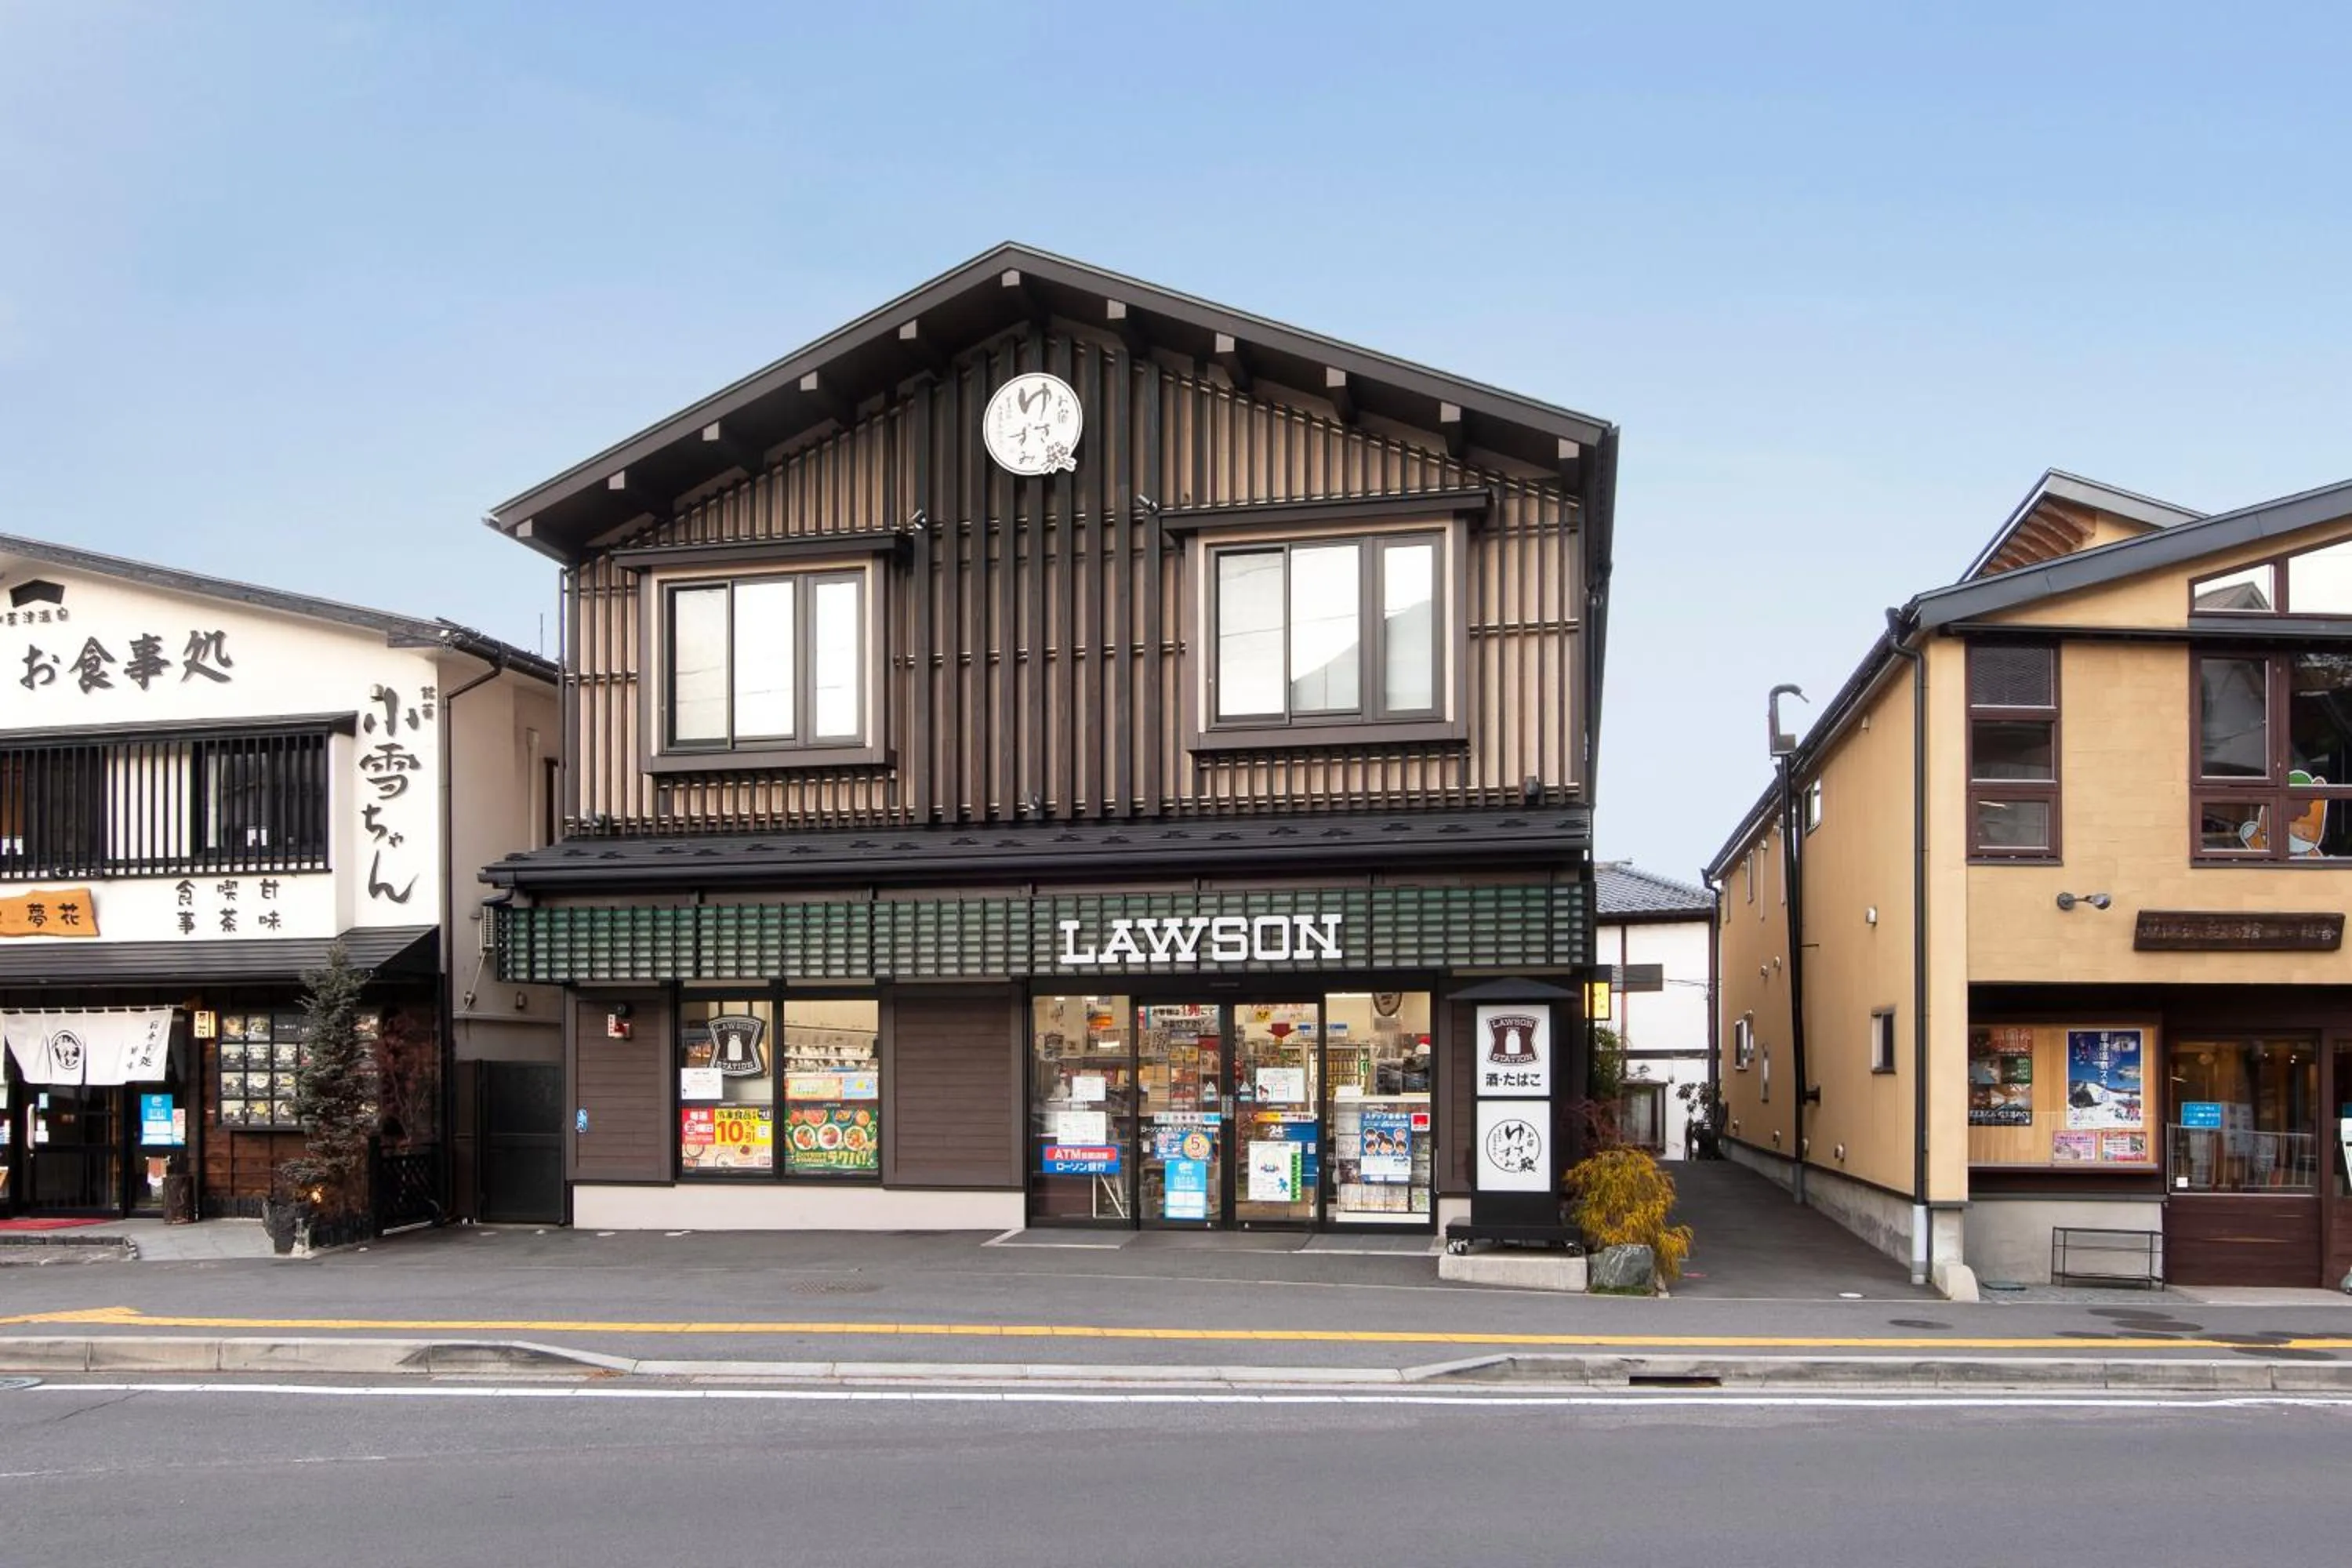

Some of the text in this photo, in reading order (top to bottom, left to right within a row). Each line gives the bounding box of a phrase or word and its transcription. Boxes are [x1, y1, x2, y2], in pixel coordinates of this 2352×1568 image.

[20, 630, 234, 695] お食事処
[359, 686, 422, 905] 小雪ちゃん
[0, 902, 80, 928] 夢花
[175, 879, 197, 935] 食事
[259, 877, 281, 931] 甘味
[1059, 913, 1343, 964] LAWSON
[715, 1022, 753, 1033] LAWSON
[1493, 1018, 1534, 1029] LAWSON
[1269, 1124, 1284, 1138] 24
[1054, 1148, 1081, 1160] ATM
